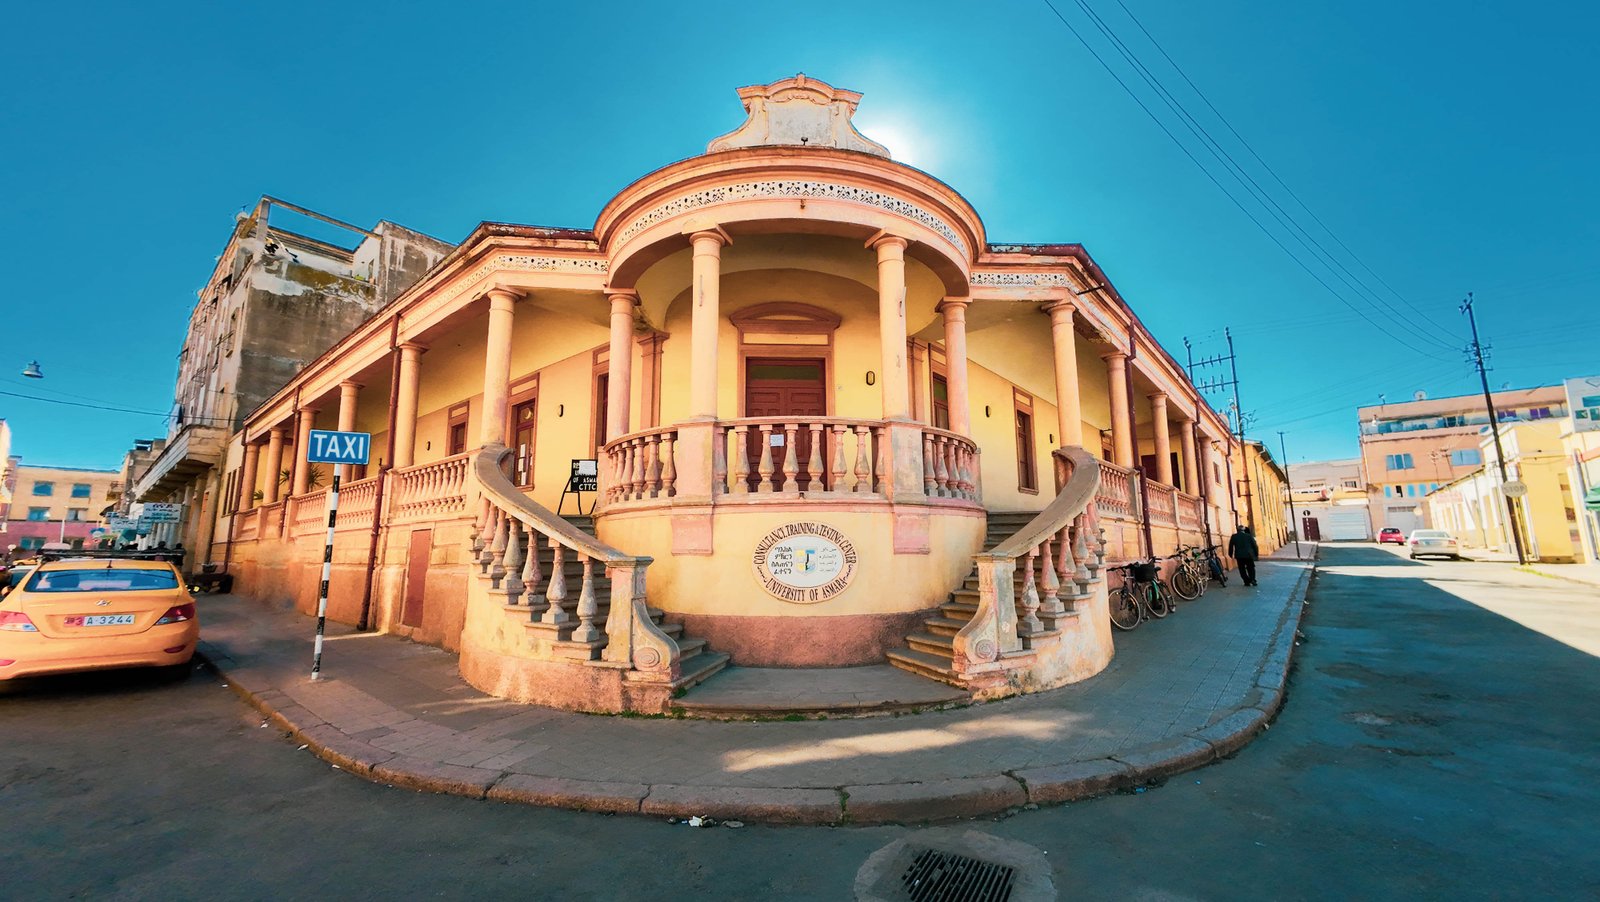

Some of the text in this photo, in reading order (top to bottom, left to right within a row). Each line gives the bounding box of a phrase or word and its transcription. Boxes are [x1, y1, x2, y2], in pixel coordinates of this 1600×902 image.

[313, 433, 364, 459] TAXI
[785, 522, 815, 537] TRAINING
[819, 524, 844, 544] TESTING
[839, 540, 857, 564] CENTER
[765, 576, 848, 602] UNIVERSITY OF ASMARA
